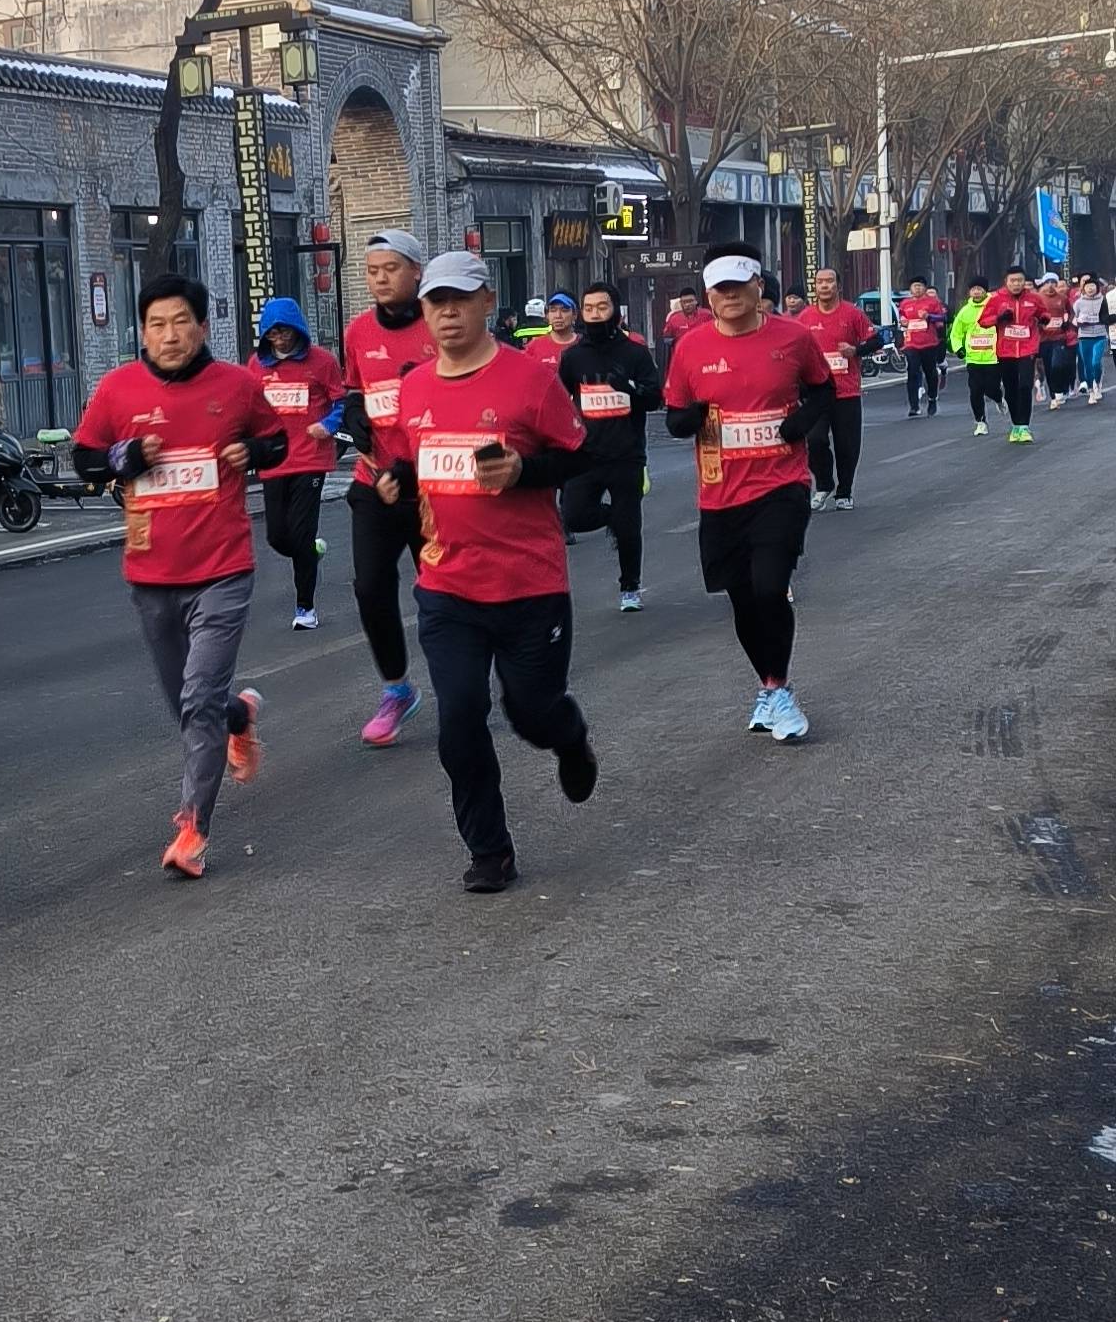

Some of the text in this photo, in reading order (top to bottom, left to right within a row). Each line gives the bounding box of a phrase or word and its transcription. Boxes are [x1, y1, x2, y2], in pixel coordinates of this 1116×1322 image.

[733, 425, 782, 443] 11532
[430, 453, 476, 473] 1061
[147, 466, 204, 488] 10139
